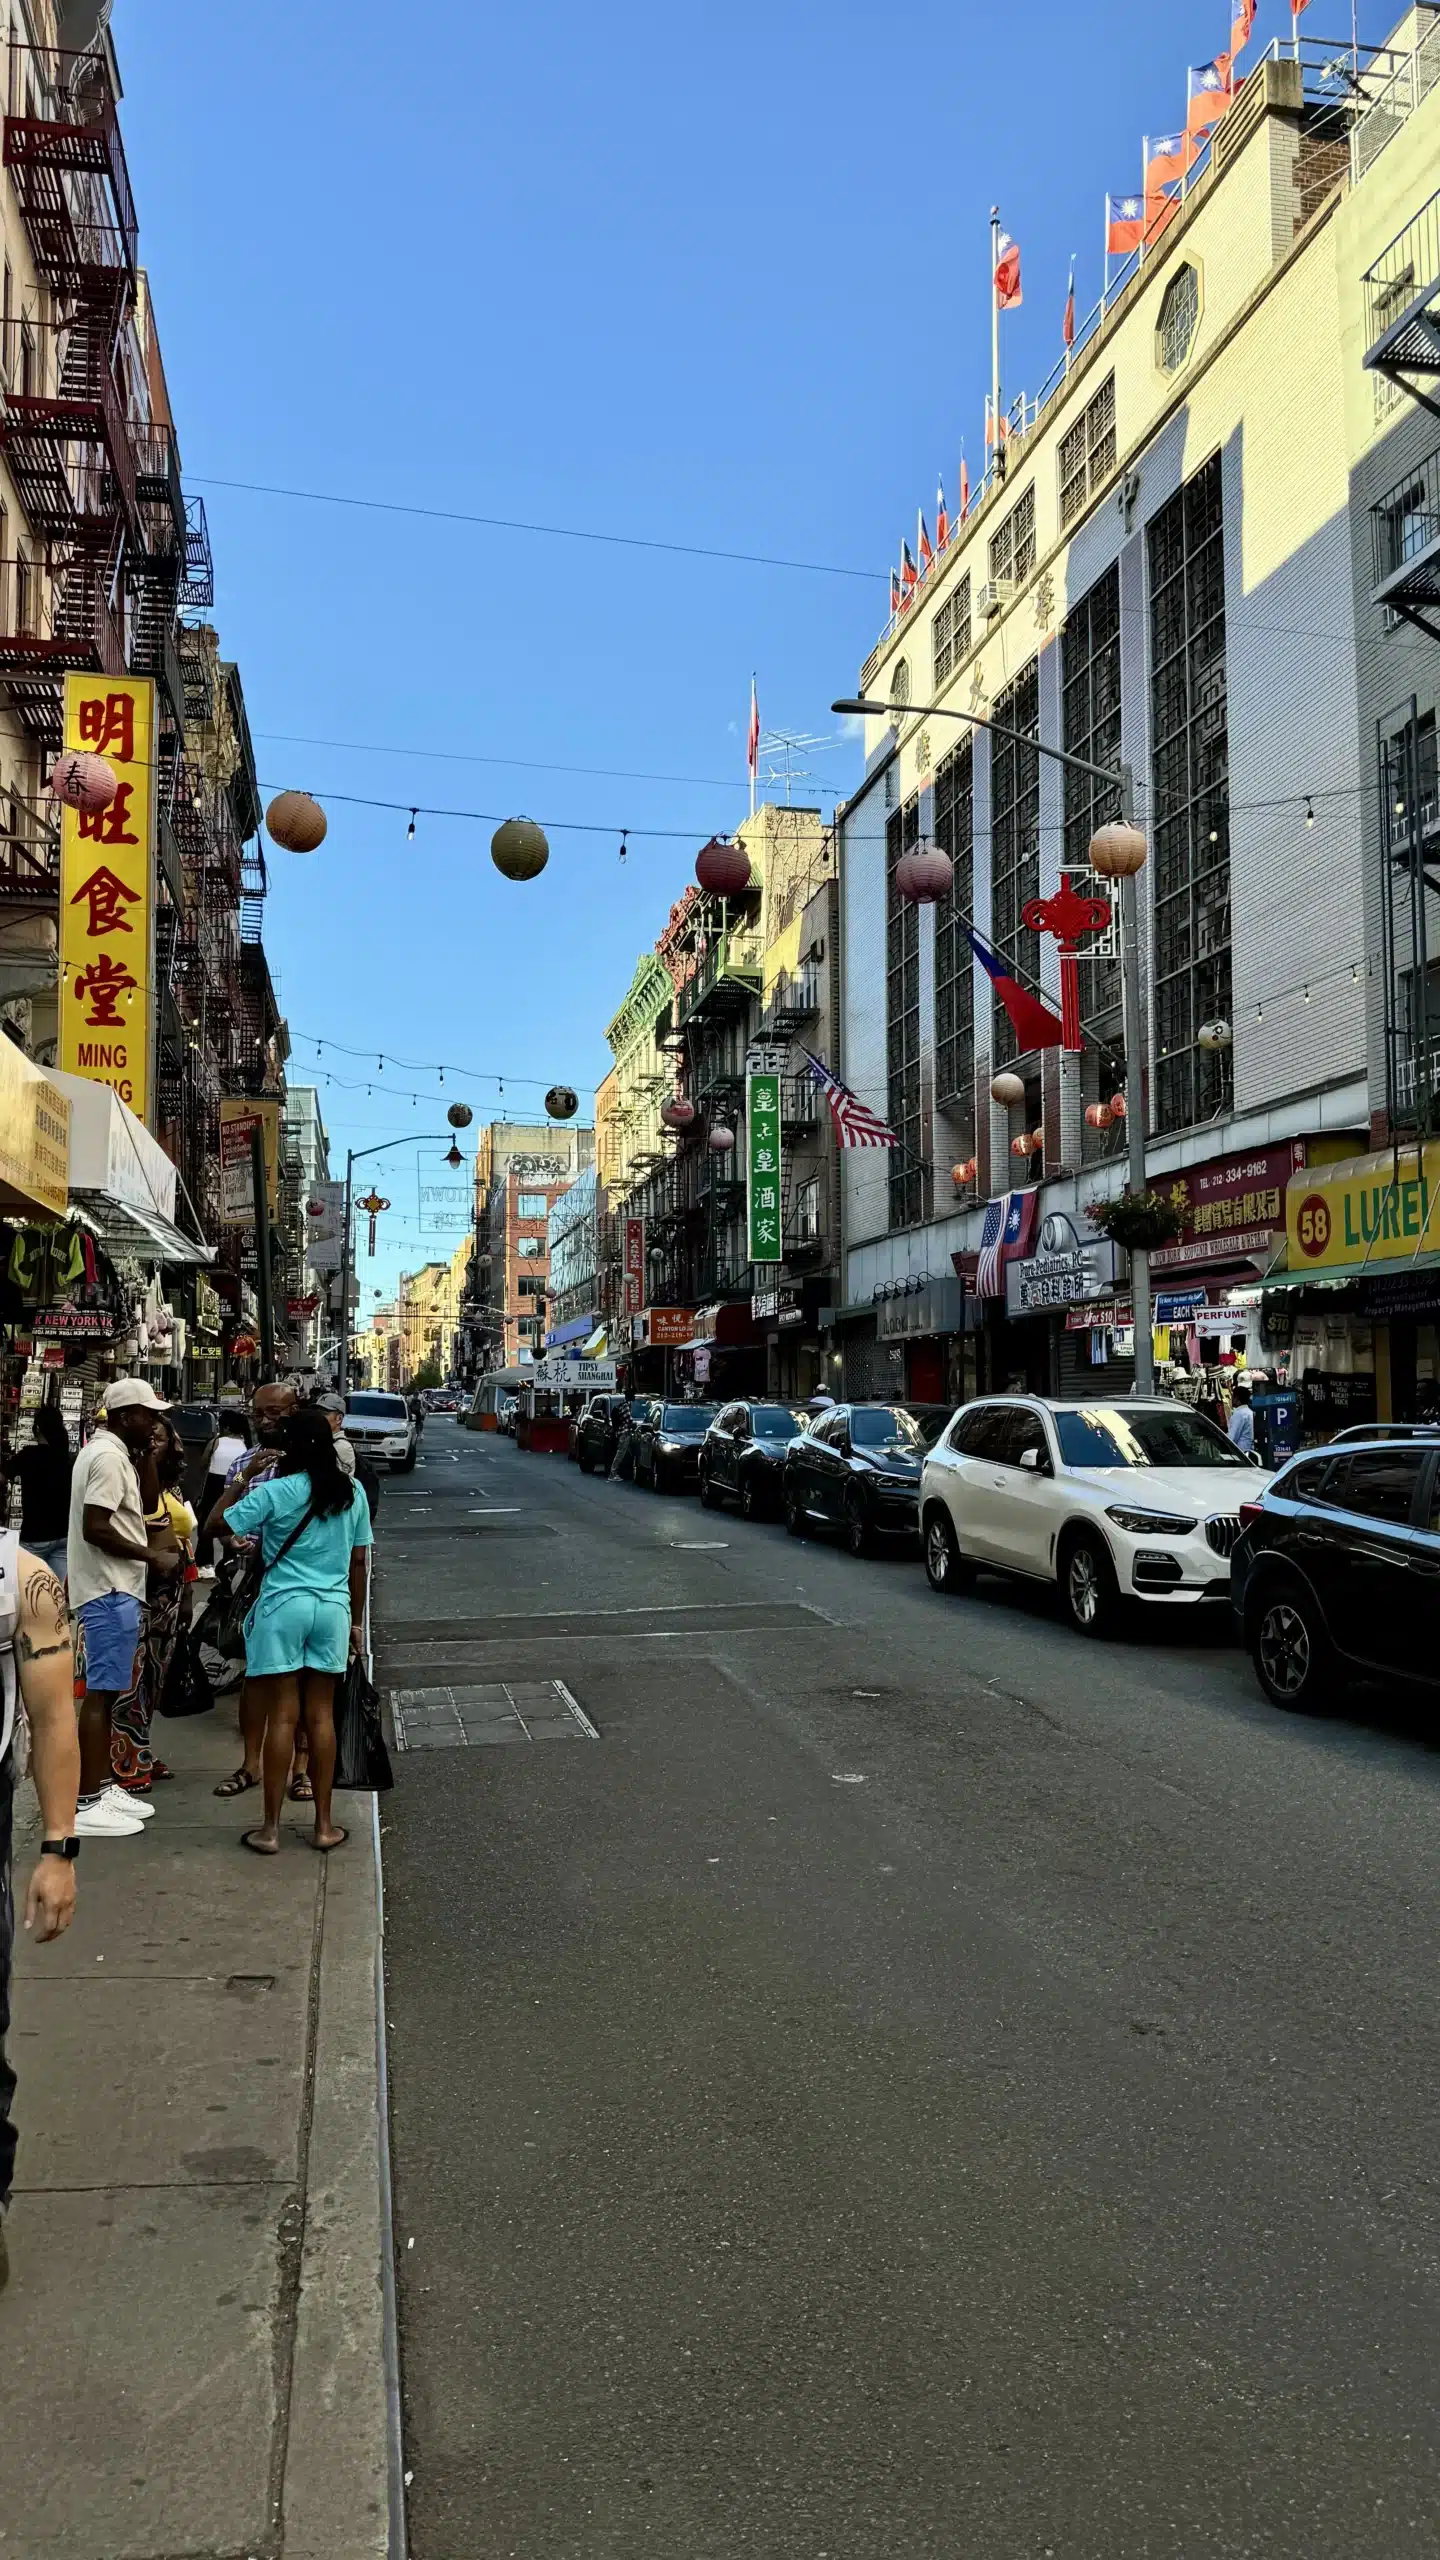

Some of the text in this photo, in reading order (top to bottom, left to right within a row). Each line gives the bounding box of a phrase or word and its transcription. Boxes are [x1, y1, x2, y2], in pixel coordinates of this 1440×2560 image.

[62, 760, 91, 797] 春
[70, 693, 142, 1026] 明旺食堂
[78, 1043, 127, 1068] MING
[222, 1125, 230, 1136] NO
[1213, 1175, 1222, 1185] 212
[1225, 1160, 1267, 1183] 334-9162
[1302, 1208, 1327, 1244] 58
[1155, 1252, 1167, 1265] NEW
[1167, 1247, 1181, 1262] YORK
[1184, 1242, 1209, 1260] SOUVENIR
[1210, 1236, 1240, 1255] WHOLESALE
[1247, 1232, 1268, 1249] RETAIL
[44, 1315, 68, 1325] NEW
[70, 1316, 98, 1326] YORK
[1173, 1306, 1190, 1319] EACH
[1196, 1310, 1247, 1320] PERFUME
[1267, 1316, 1289, 1332] $10
[536, 1361, 571, 1383] 蘇杭
[577, 1371, 613, 1380] SHANGHAI
[578, 1362, 598, 1371] TIPSY
[1276, 1407, 1288, 1425] P
